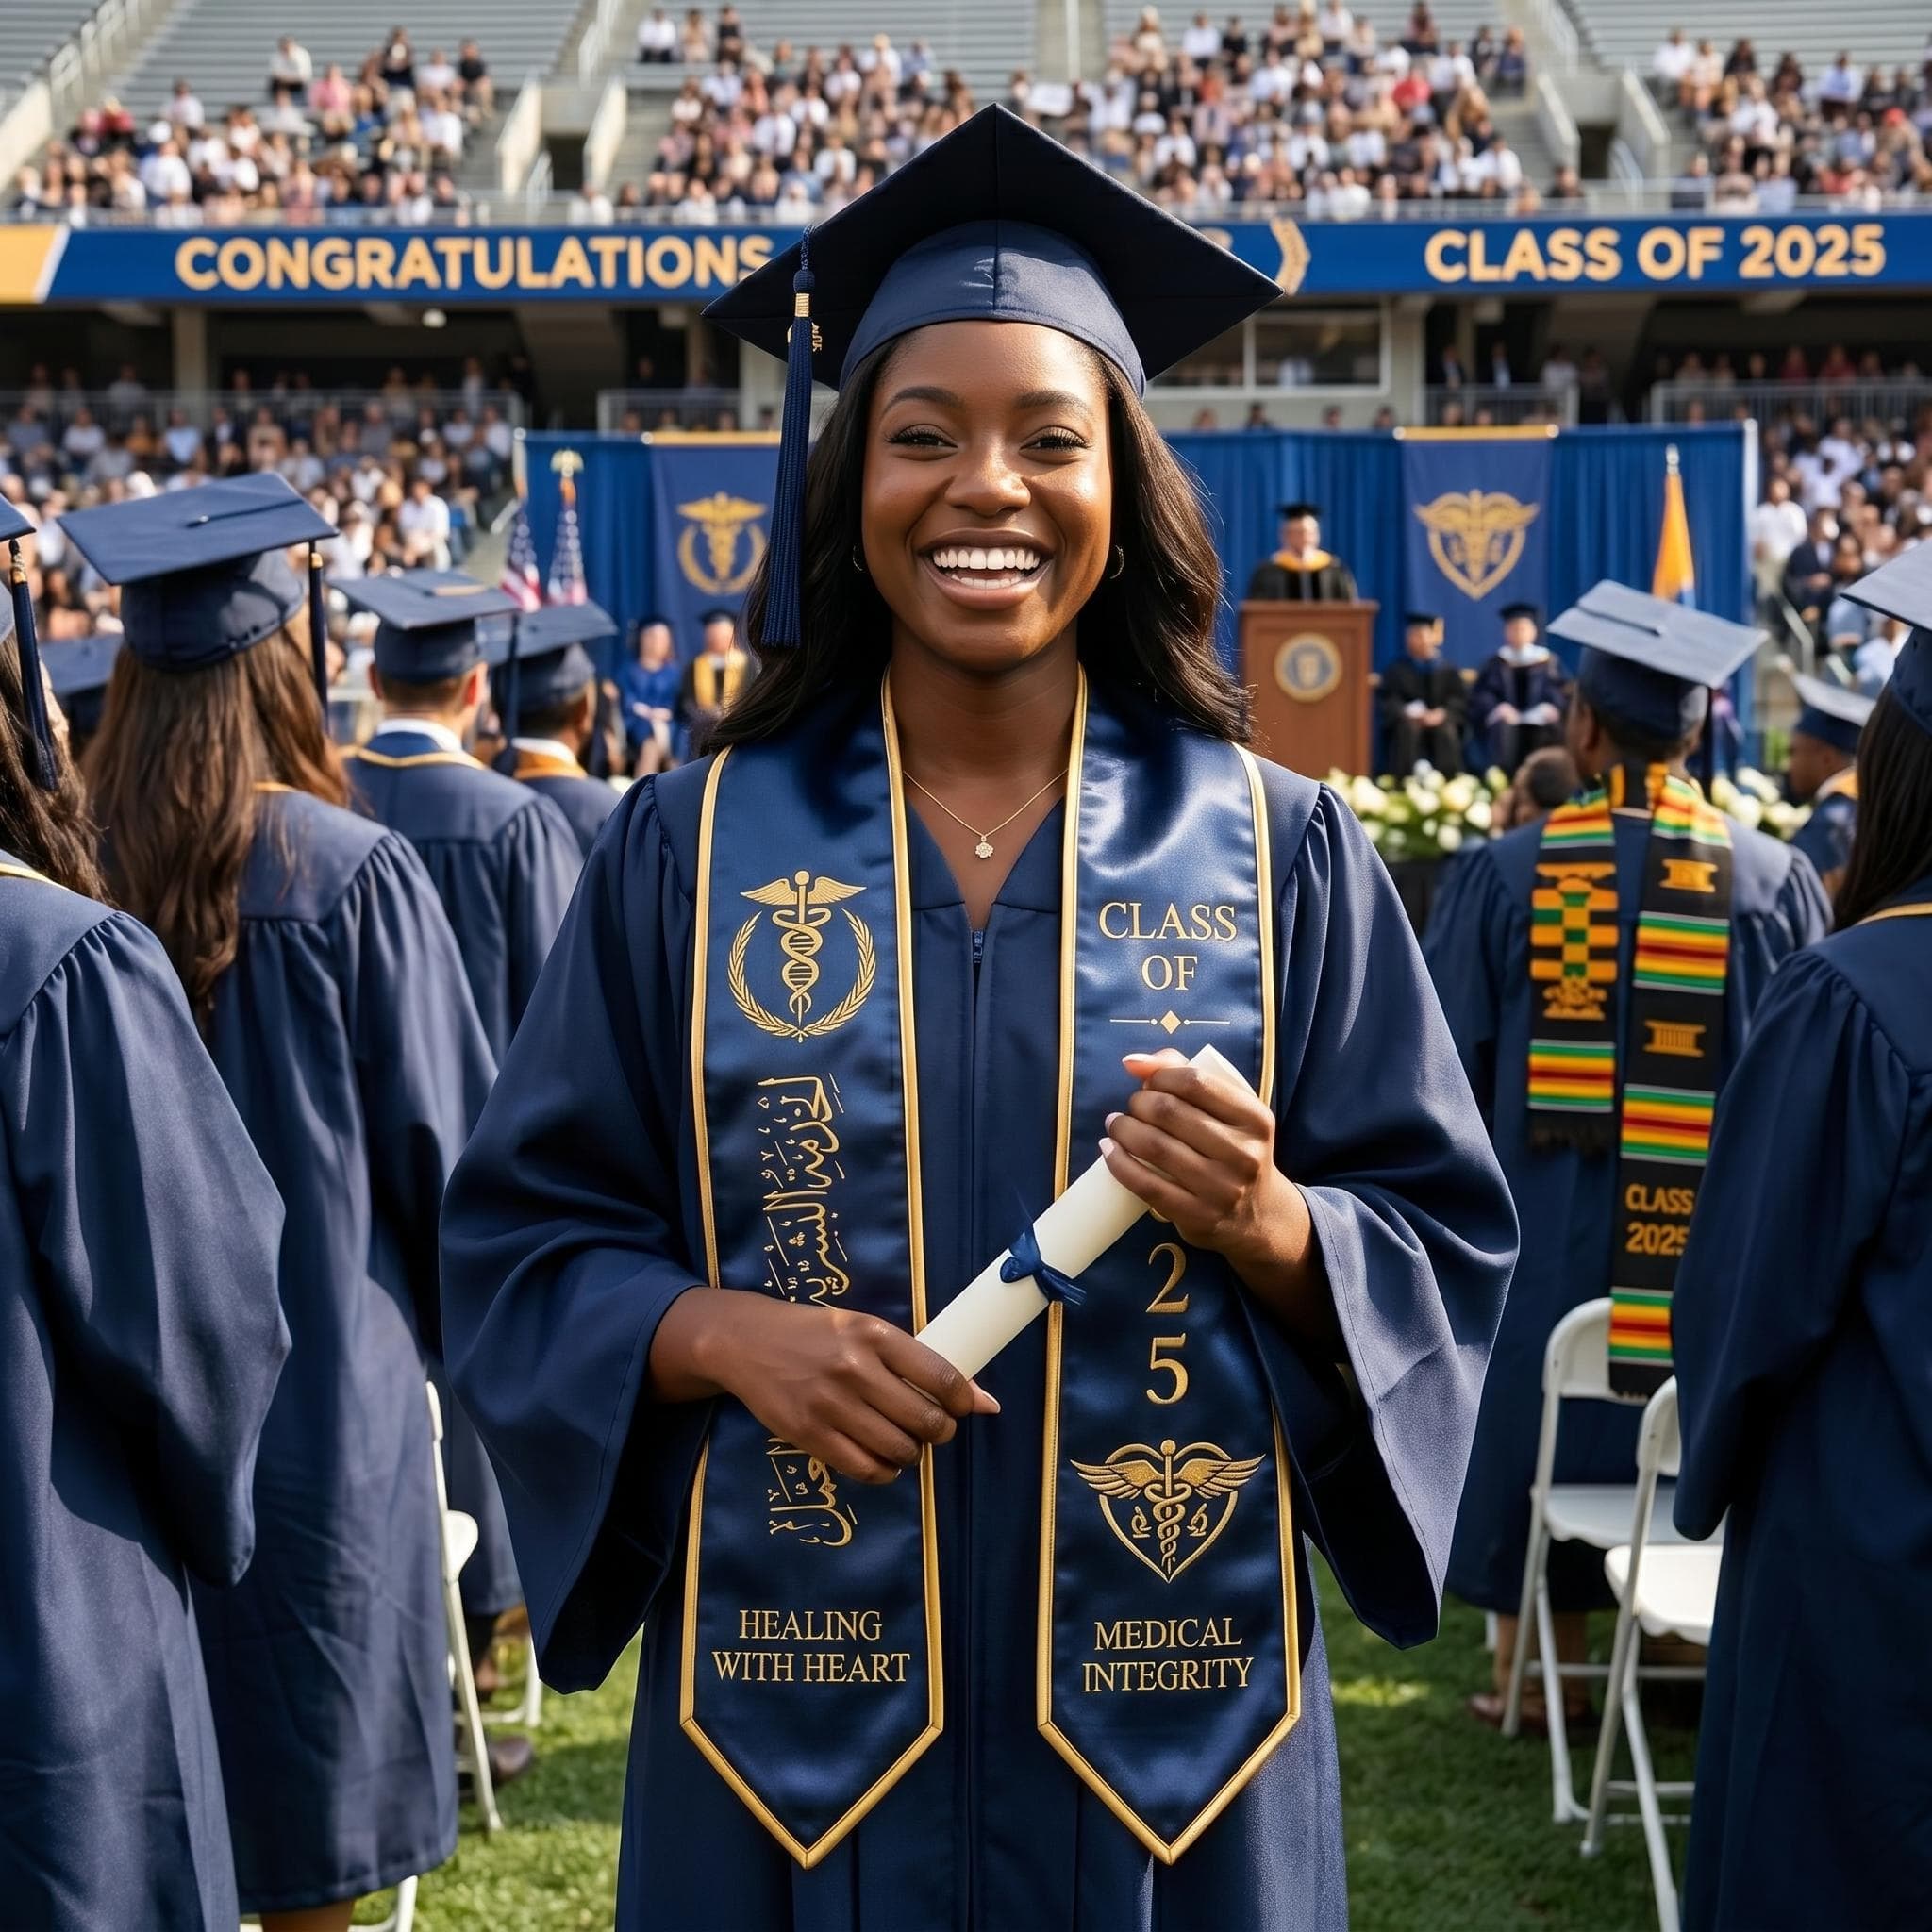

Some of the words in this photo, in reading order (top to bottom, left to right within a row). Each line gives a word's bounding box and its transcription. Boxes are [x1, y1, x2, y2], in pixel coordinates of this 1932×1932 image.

[175, 236, 774, 290] CONGRATULATIONS
[1424, 229, 1621, 282] CLASS
[1637, 227, 1724, 281] OF
[1740, 224, 1886, 278] 2025
[1099, 902, 1238, 941] CLASS
[1141, 955, 1198, 991] OF
[1624, 1182, 1695, 1216] CLASS
[739, 1609, 883, 1641] HEALING
[1094, 1617, 1242, 1651] MEDICAL
[711, 1651, 794, 1682] WITH
[803, 1653, 910, 1683] HEART
[1081, 1657, 1255, 1692] INTEGRITY
